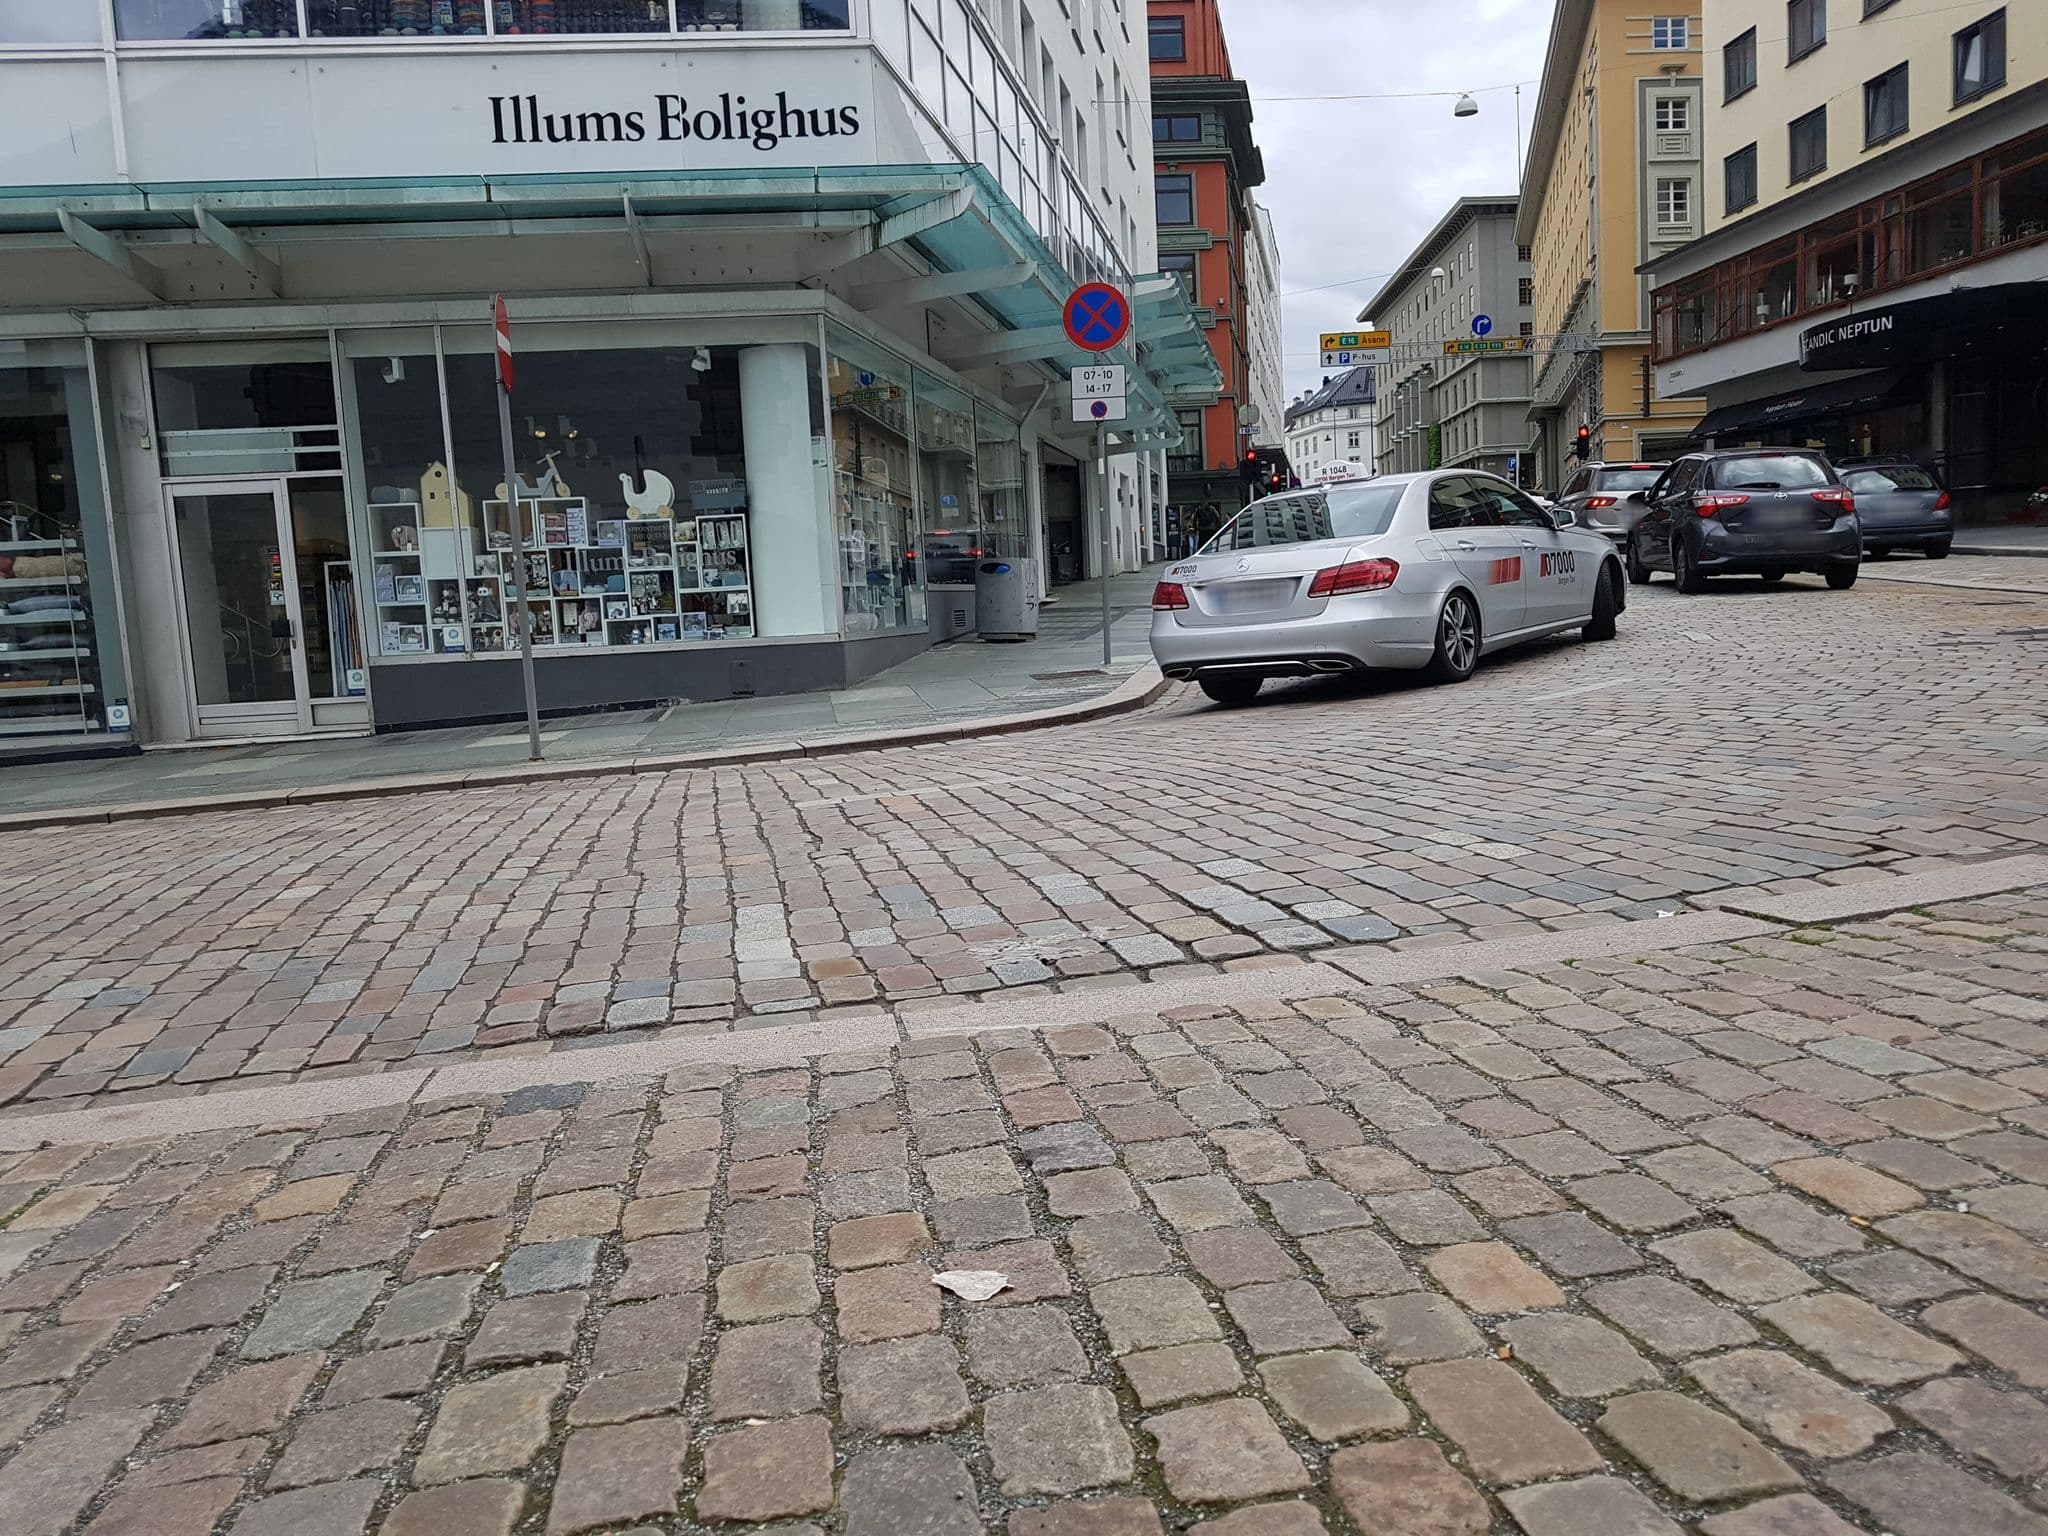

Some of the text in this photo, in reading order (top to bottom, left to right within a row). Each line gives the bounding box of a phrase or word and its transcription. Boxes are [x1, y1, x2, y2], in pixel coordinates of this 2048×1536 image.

[488, 91, 860, 151] Illums Bolighus
[1839, 315, 1893, 341] NEPTUN
[1361, 334, 1386, 344] Åsane
[1341, 353, 1348, 363] P
[1175, 565, 1197, 574] 07000
[1545, 550, 1575, 576] 07000
